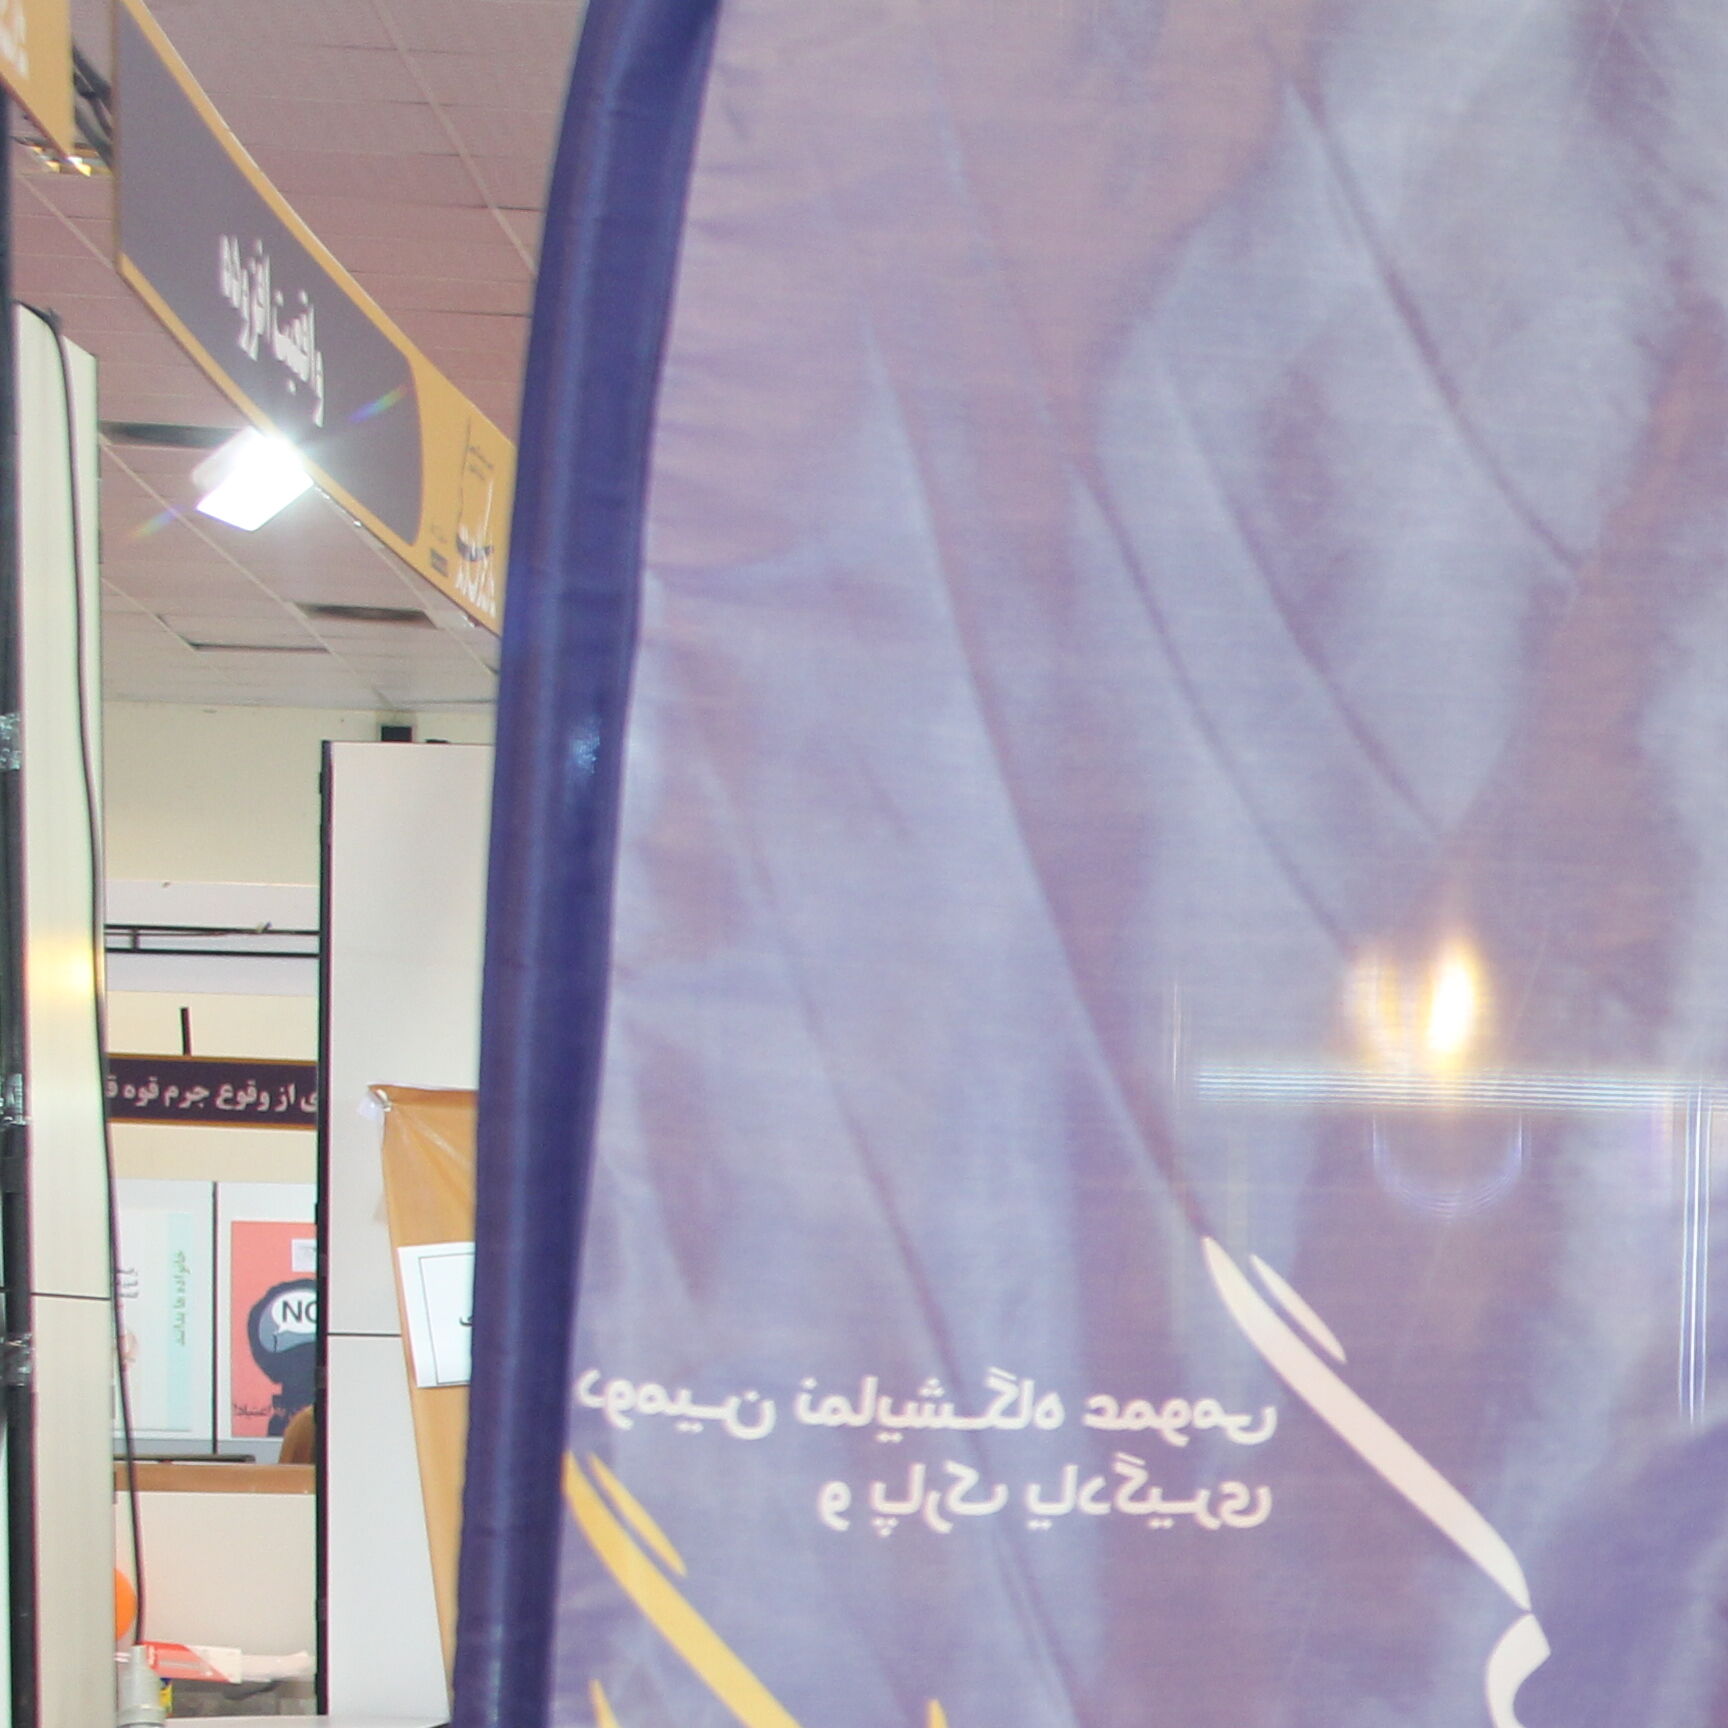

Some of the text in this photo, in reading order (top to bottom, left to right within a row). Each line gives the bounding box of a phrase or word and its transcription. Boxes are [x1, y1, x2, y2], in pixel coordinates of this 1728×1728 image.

[122, 1076, 161, 1108] قوه
[163, 1084, 210, 1109] جرم
[215, 1079, 270, 1112] وقوع
[275, 1083, 295, 1112] از
